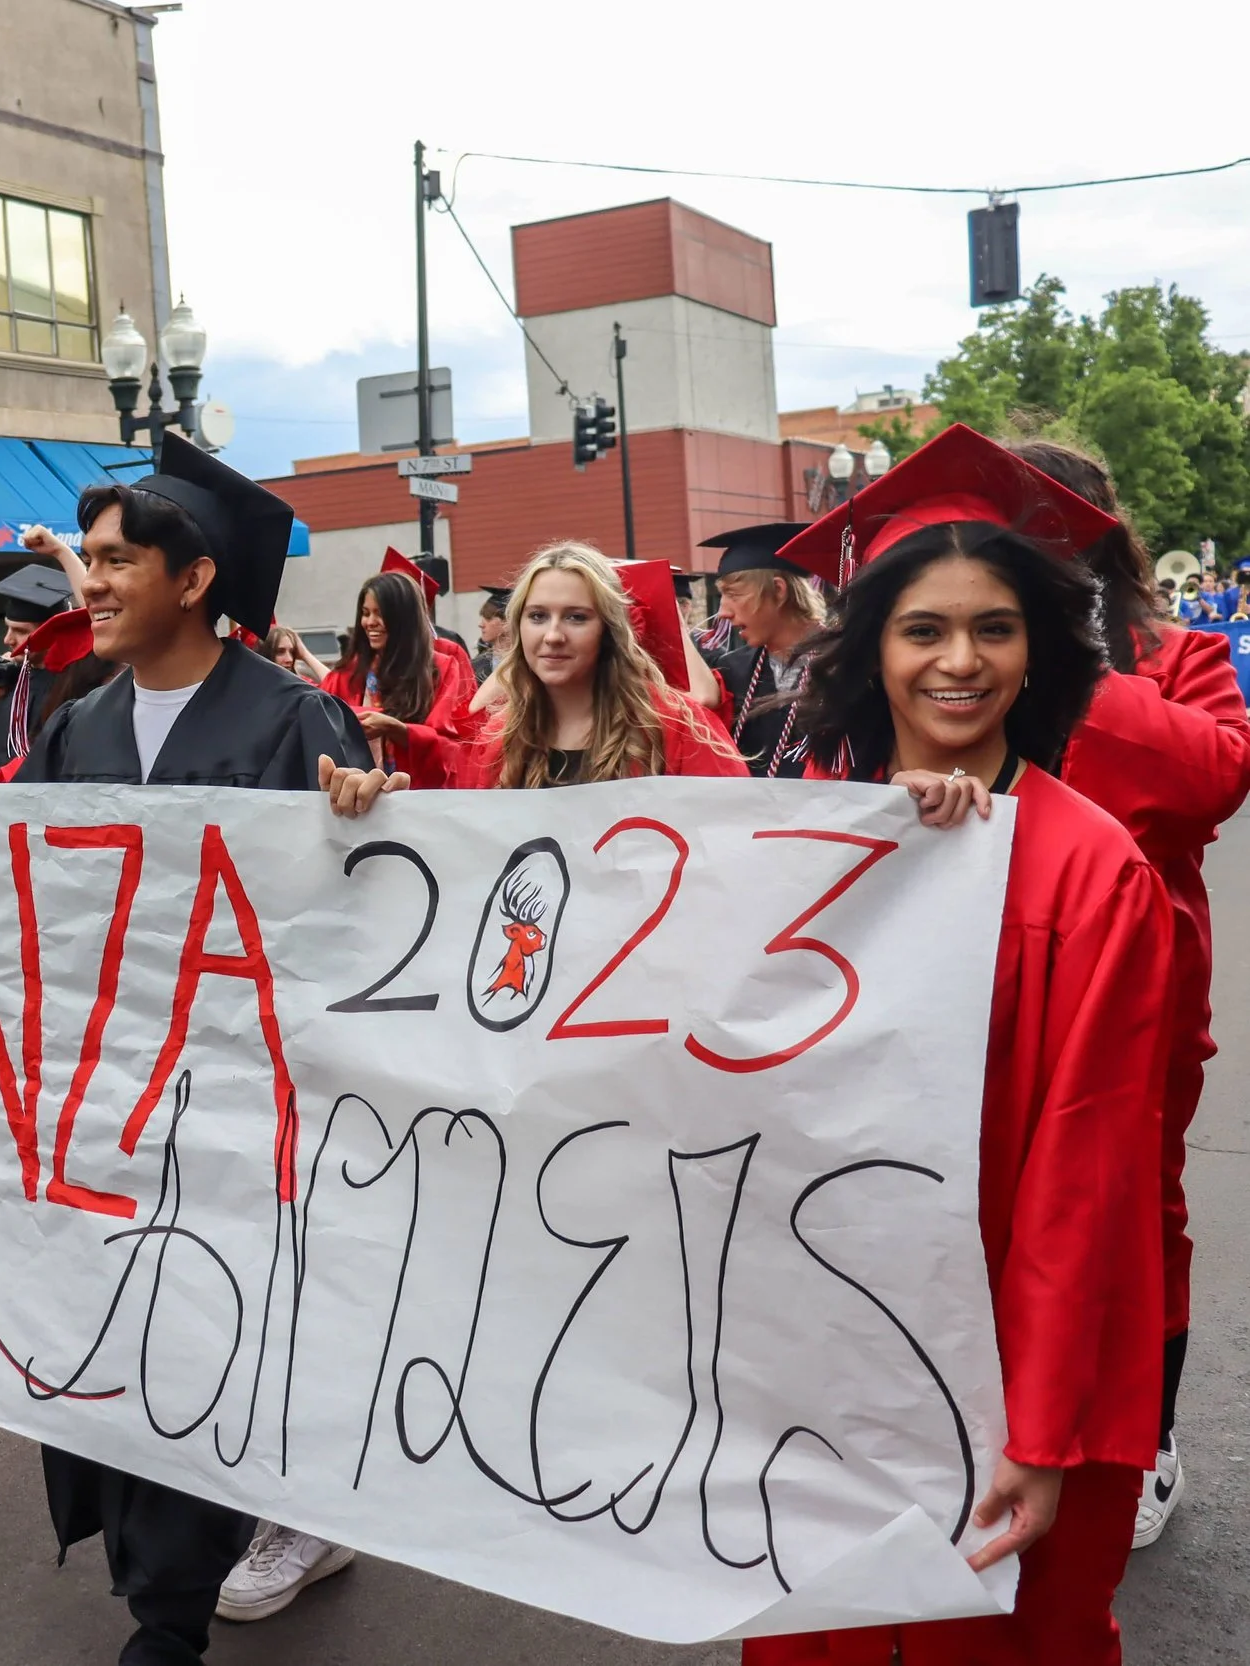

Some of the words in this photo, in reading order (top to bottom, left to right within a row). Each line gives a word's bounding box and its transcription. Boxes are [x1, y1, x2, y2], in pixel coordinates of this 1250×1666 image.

[406, 460, 418, 473] N
[444, 456, 459, 470] ST
[419, 482, 444, 497] MAIN
[326, 816, 899, 1073] 2023
